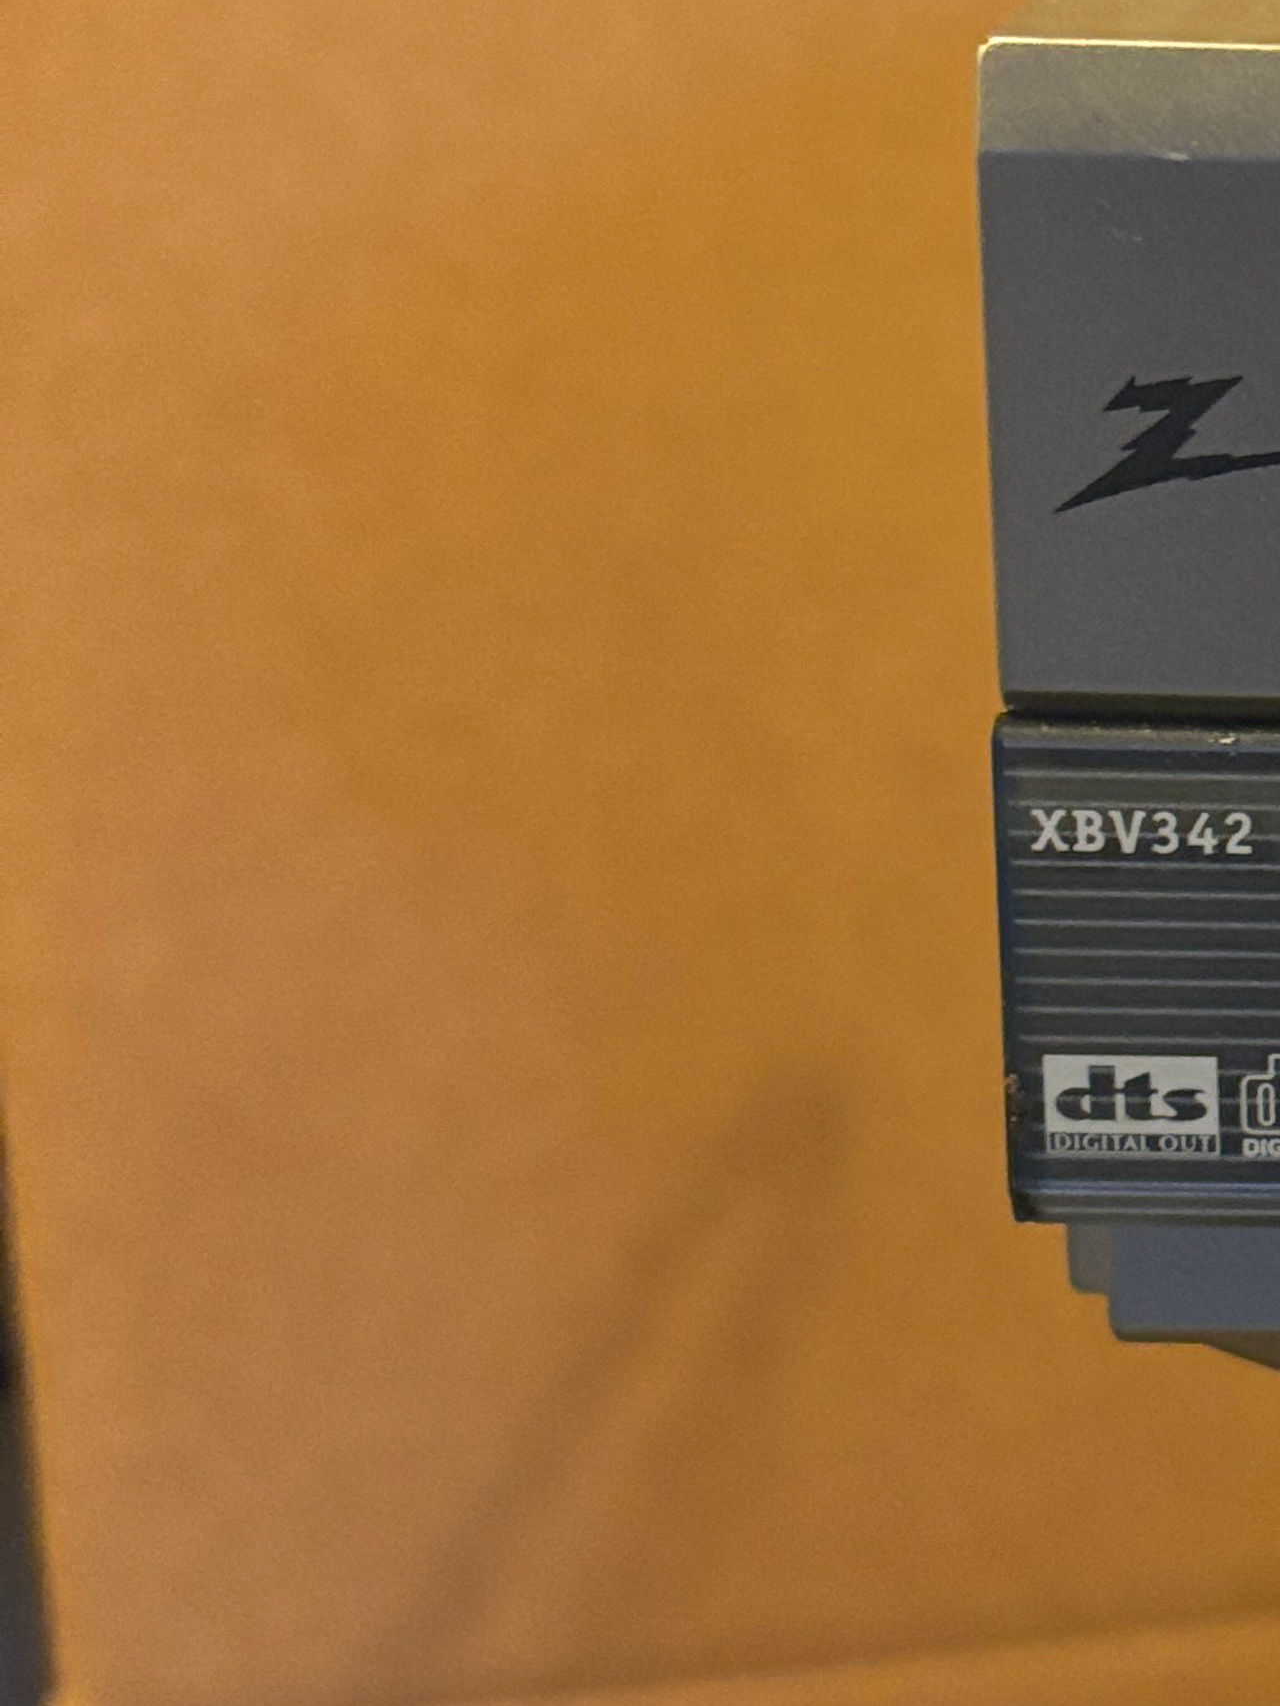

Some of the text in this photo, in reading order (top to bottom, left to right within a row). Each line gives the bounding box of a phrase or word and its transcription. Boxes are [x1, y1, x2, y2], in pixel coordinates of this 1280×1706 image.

[1030, 809, 1253, 855] XBV342
[1055, 1064, 1208, 1121] dts
[1052, 1134, 1212, 1153] DIGITAL OUT
